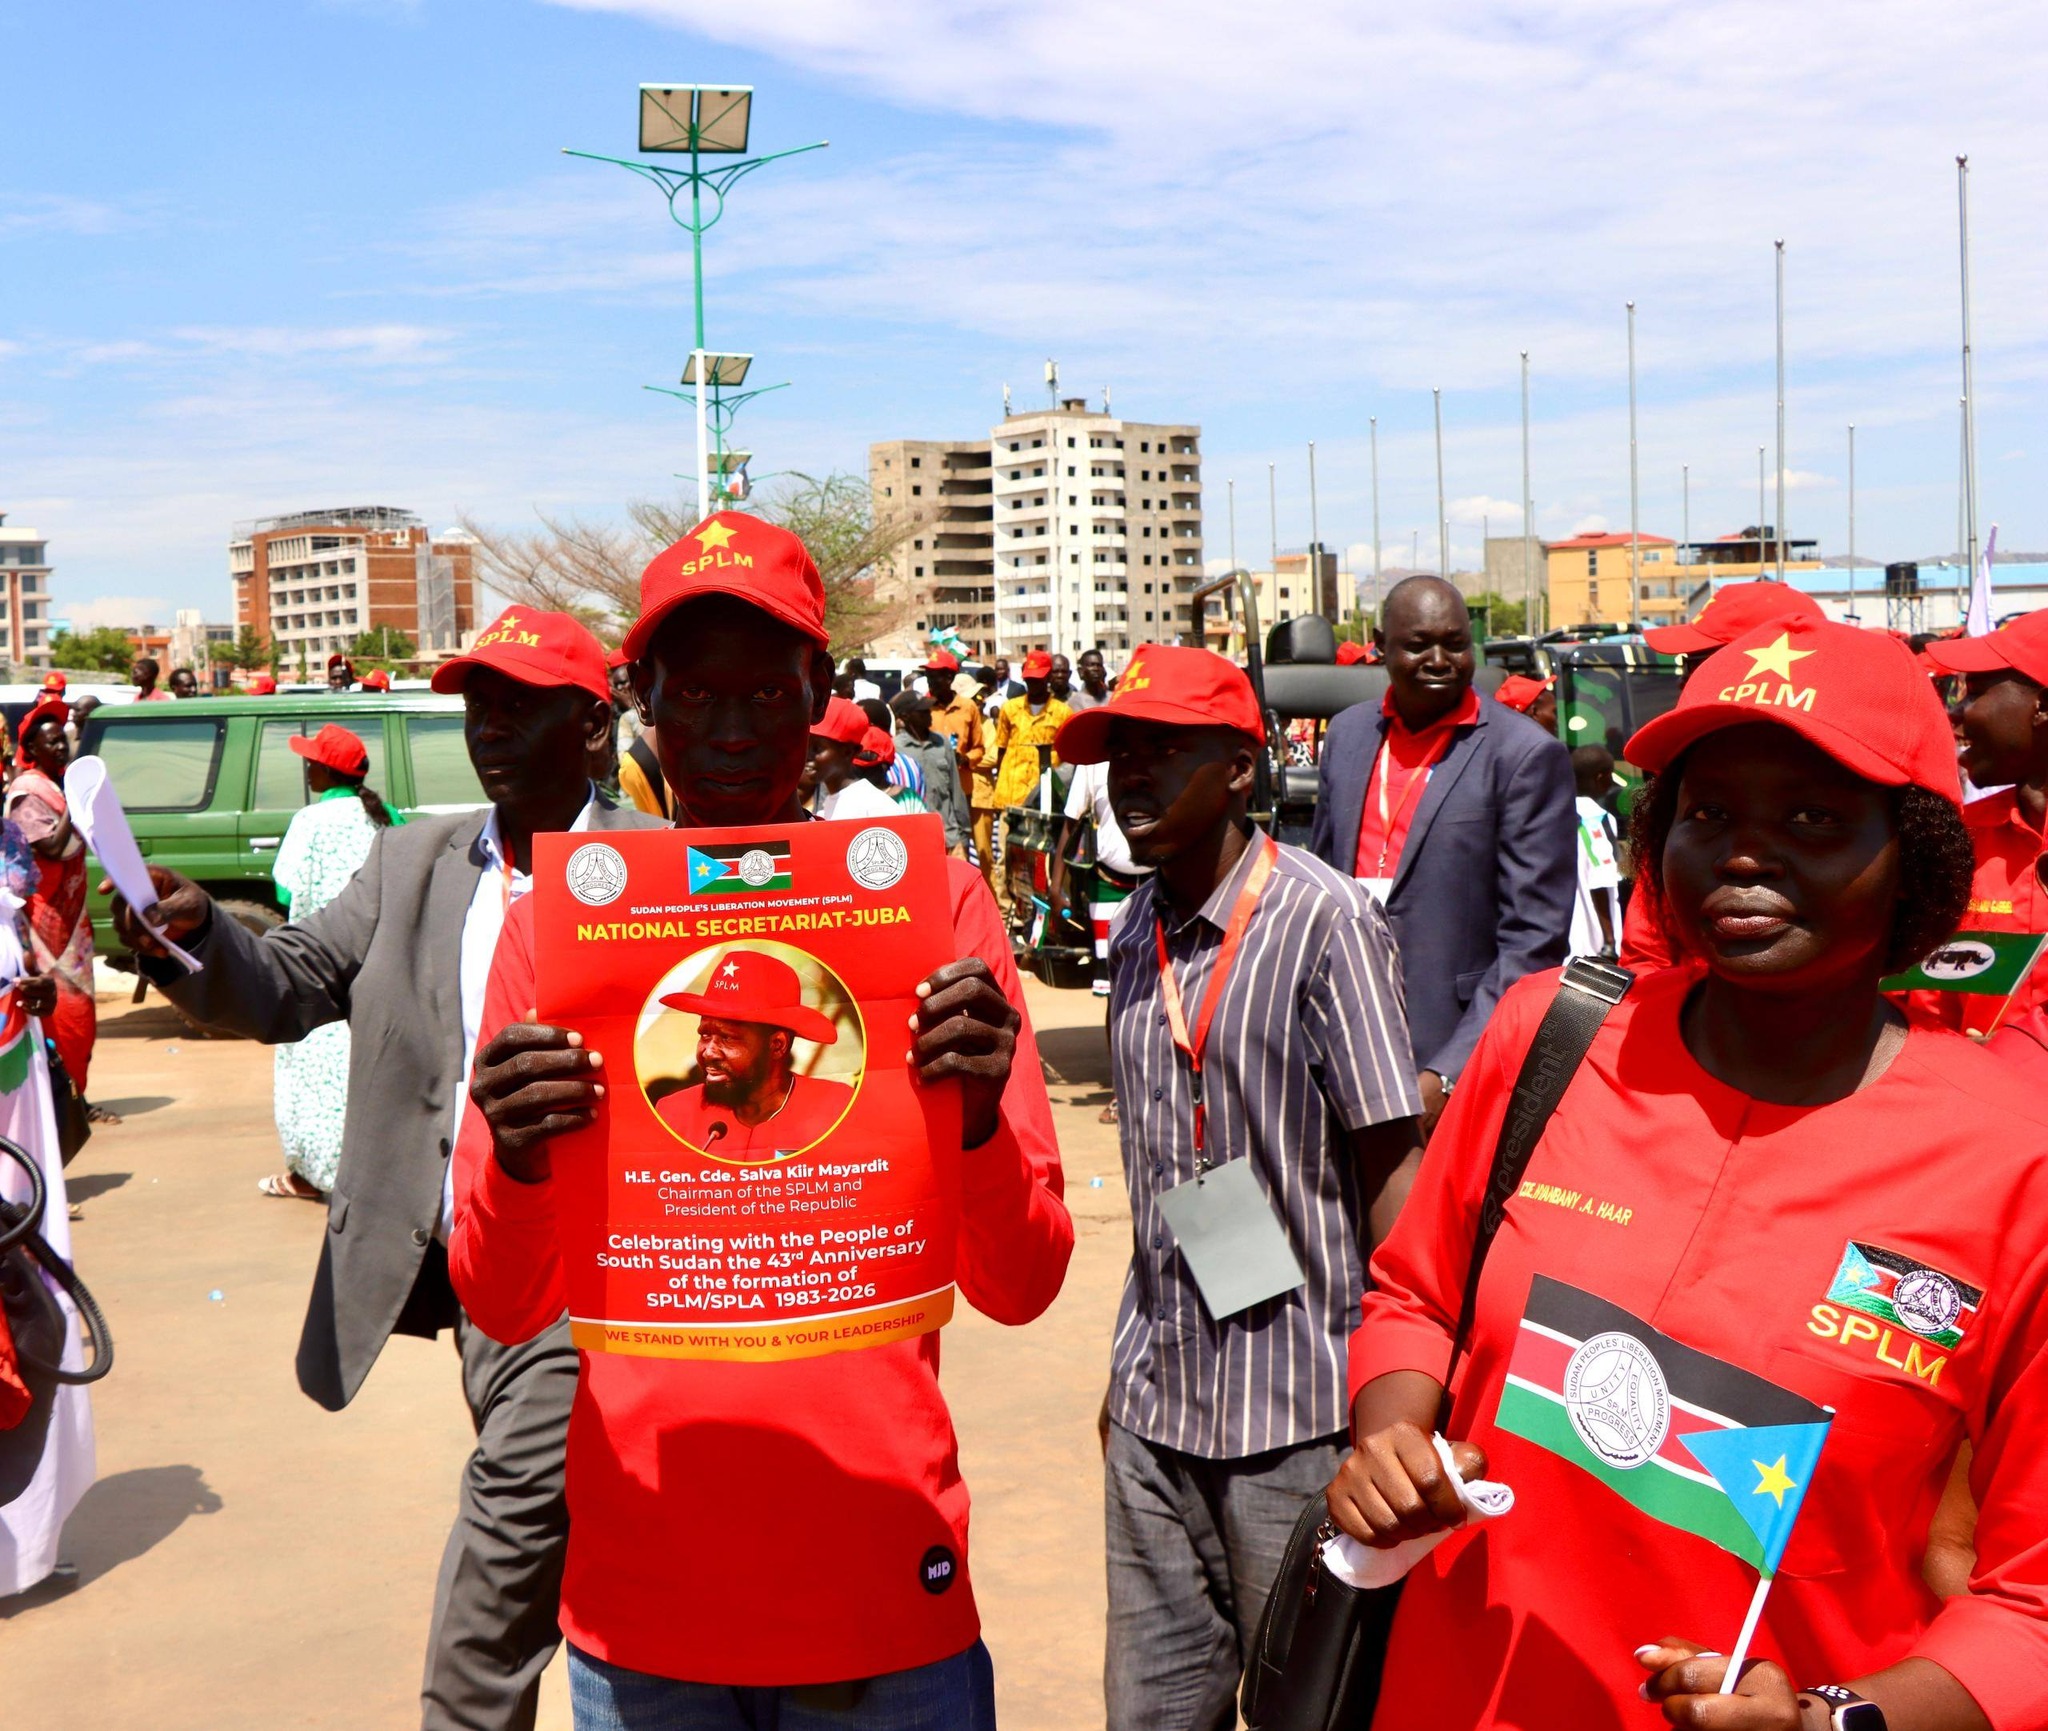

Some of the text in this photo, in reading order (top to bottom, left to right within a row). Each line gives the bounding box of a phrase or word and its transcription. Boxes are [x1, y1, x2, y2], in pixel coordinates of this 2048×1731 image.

[681, 551, 753, 576] SPLM
[473, 630, 541, 652] SPLM
[630, 894, 853, 915] SUDAN PEOPLE'S LIBERATION MOVEMENT (SPLM)
[577, 906, 911, 941] NATIONAL SECRETARIAT-JUBA
[714, 980, 739, 990] SPLM
[625, 1158, 889, 1183] H.E. Gen. Cde. Salva Kiir Mayardit
[658, 1177, 862, 1199] Chairman of the SPLM and
[665, 1195, 857, 1216] President of the Republic
[1596, 1201, 1633, 1226] HAAR
[608, 1219, 914, 1254] Celebrating with the People of
[596, 1238, 927, 1270] South Sudan the 43rd Anniversary
[668, 1266, 858, 1290] of the formation of
[646, 1283, 876, 1310] SPLM/SPLA 1983-2026
[605, 1312, 925, 1348] WE STAND WITH YOU & YOUR LEADERSHIP
[1806, 1304, 1948, 1387] SPLM
[1569, 1364, 1583, 1398] SUDAN
[1621, 1340, 1660, 1386] LIBERATION
[1647, 1388, 1664, 1448] MOVEMENT
[1590, 1363, 1626, 1399] UNITY
[1606, 1398, 1628, 1419] SPLM
[1629, 1373, 1643, 1431] EQUALITY
[1587, 1407, 1635, 1445] PROGRESS
